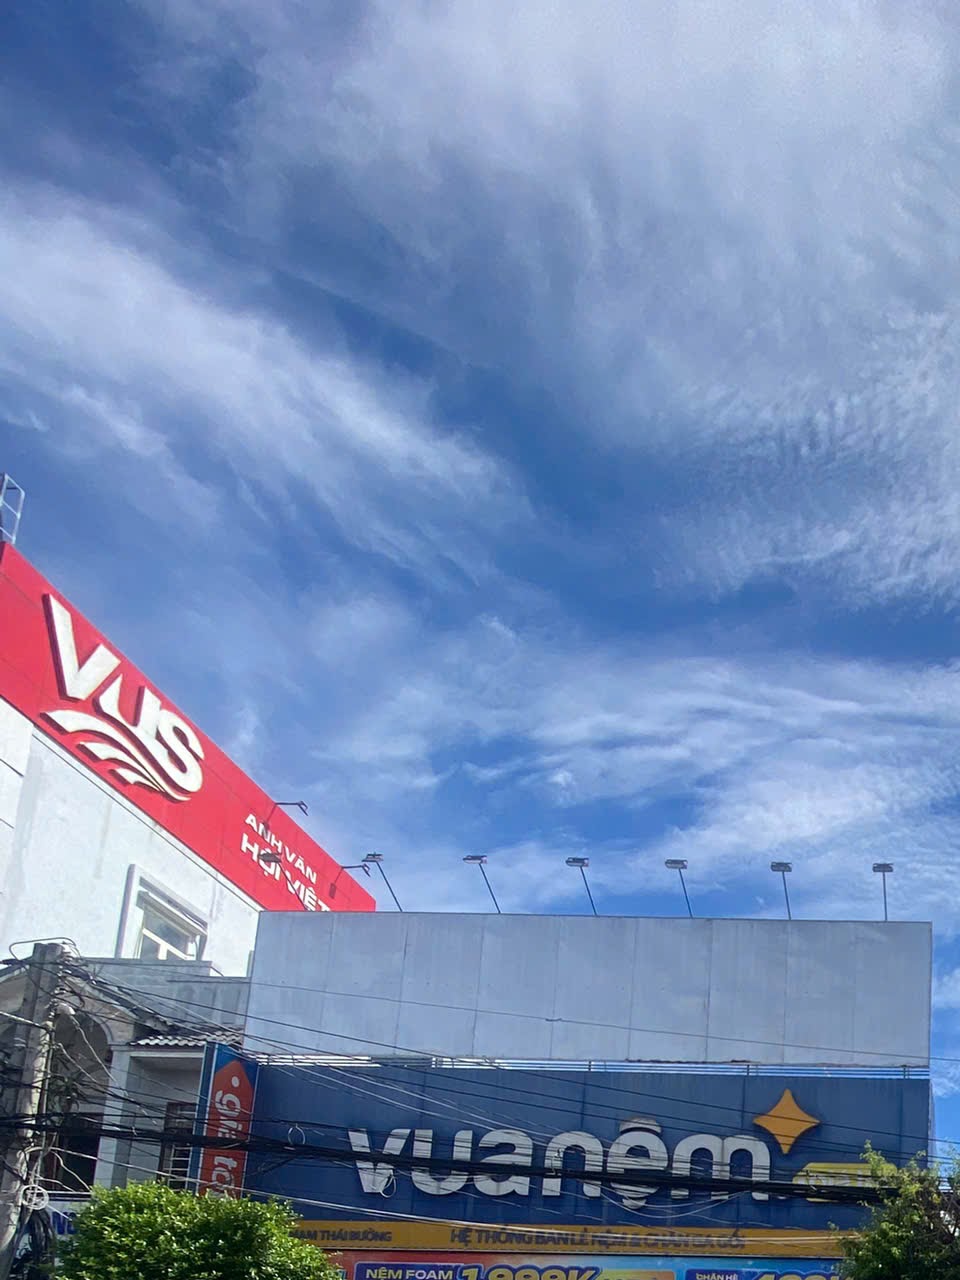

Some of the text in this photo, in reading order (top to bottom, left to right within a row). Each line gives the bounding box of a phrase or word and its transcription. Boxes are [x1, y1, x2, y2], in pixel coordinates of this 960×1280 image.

[43, 594, 204, 800] VUS
[245, 813, 317, 885] ANH VĂN
[405, 1268, 453, 1280] FOAM
